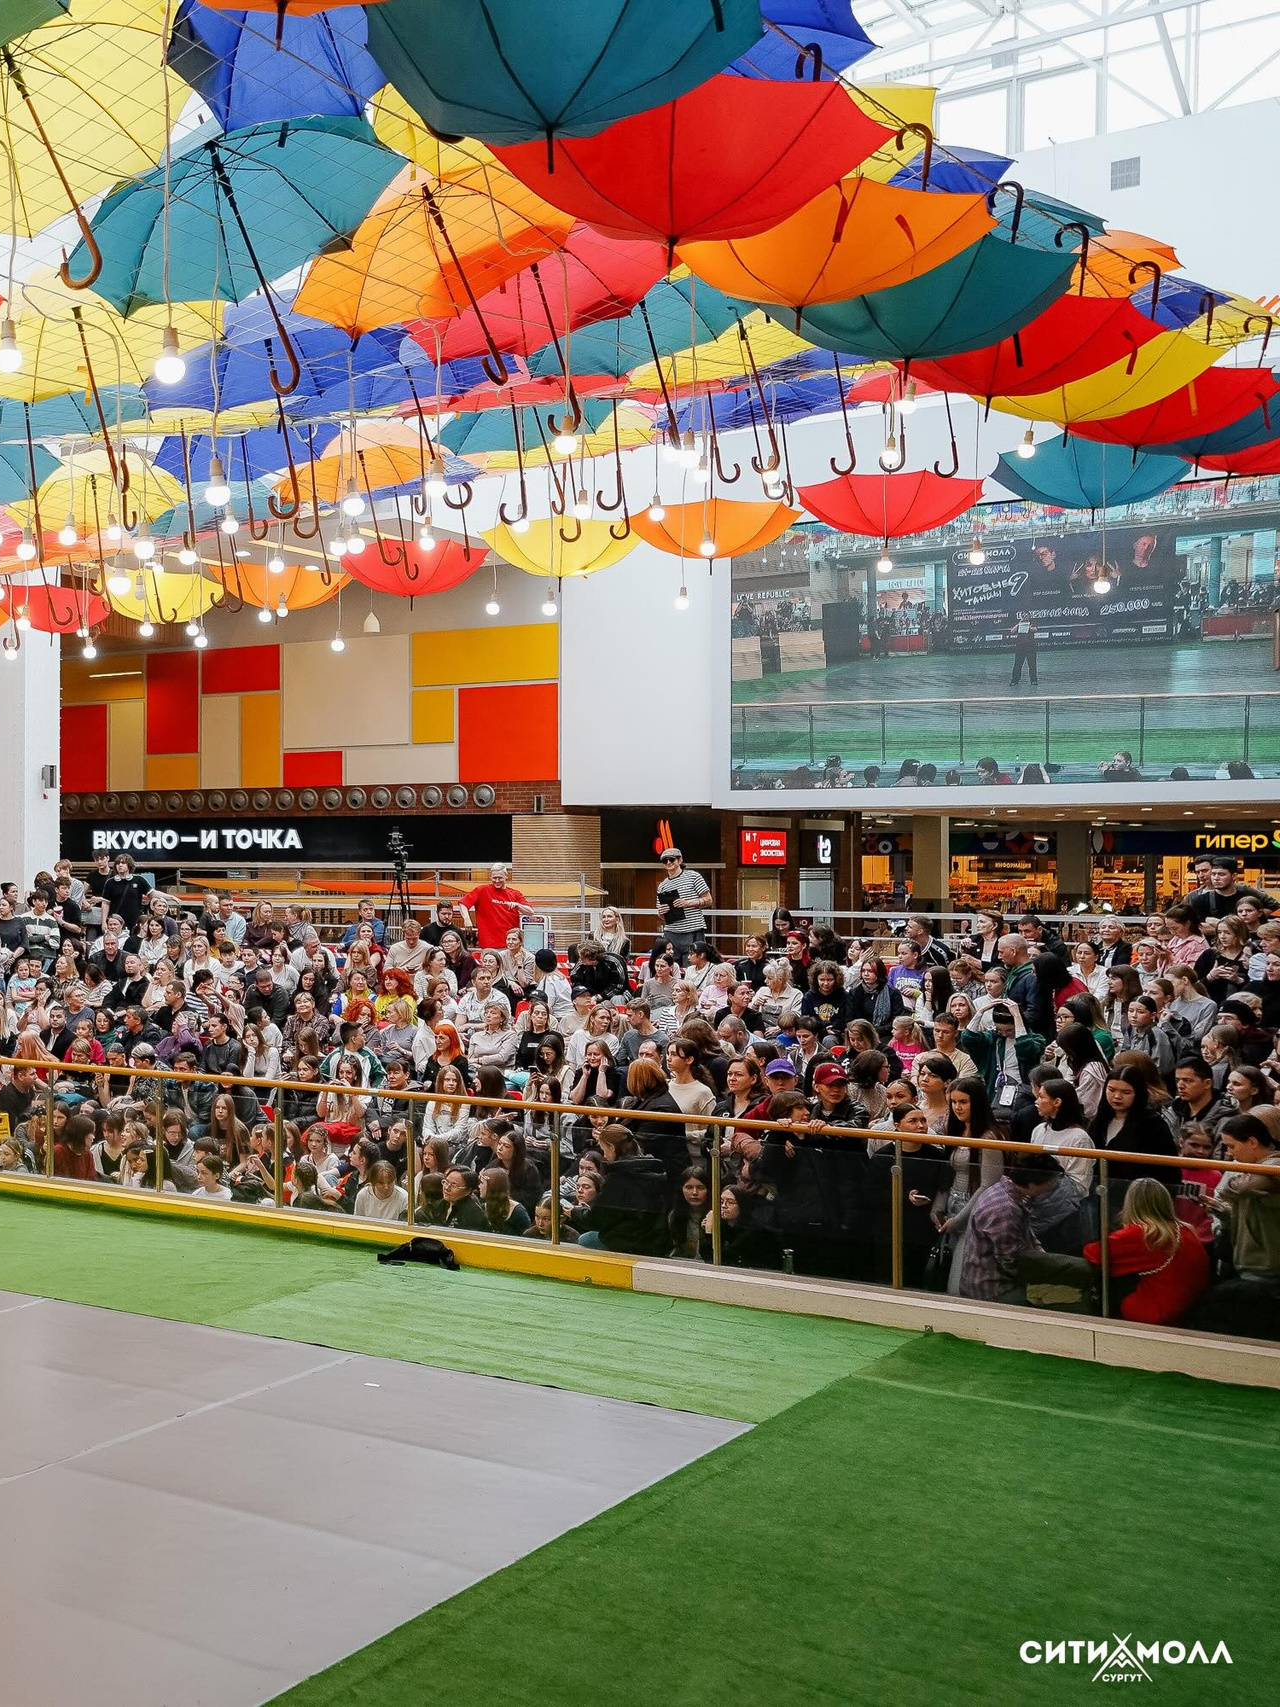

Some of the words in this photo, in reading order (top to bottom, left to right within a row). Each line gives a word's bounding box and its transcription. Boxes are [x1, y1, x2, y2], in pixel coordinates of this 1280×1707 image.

[757, 590, 790, 599] REPUBLIC
[92, 830, 179, 849] ВКУСНО
[221, 829, 303, 849] ТОЧКА
[1195, 834, 1269, 852] гипер
